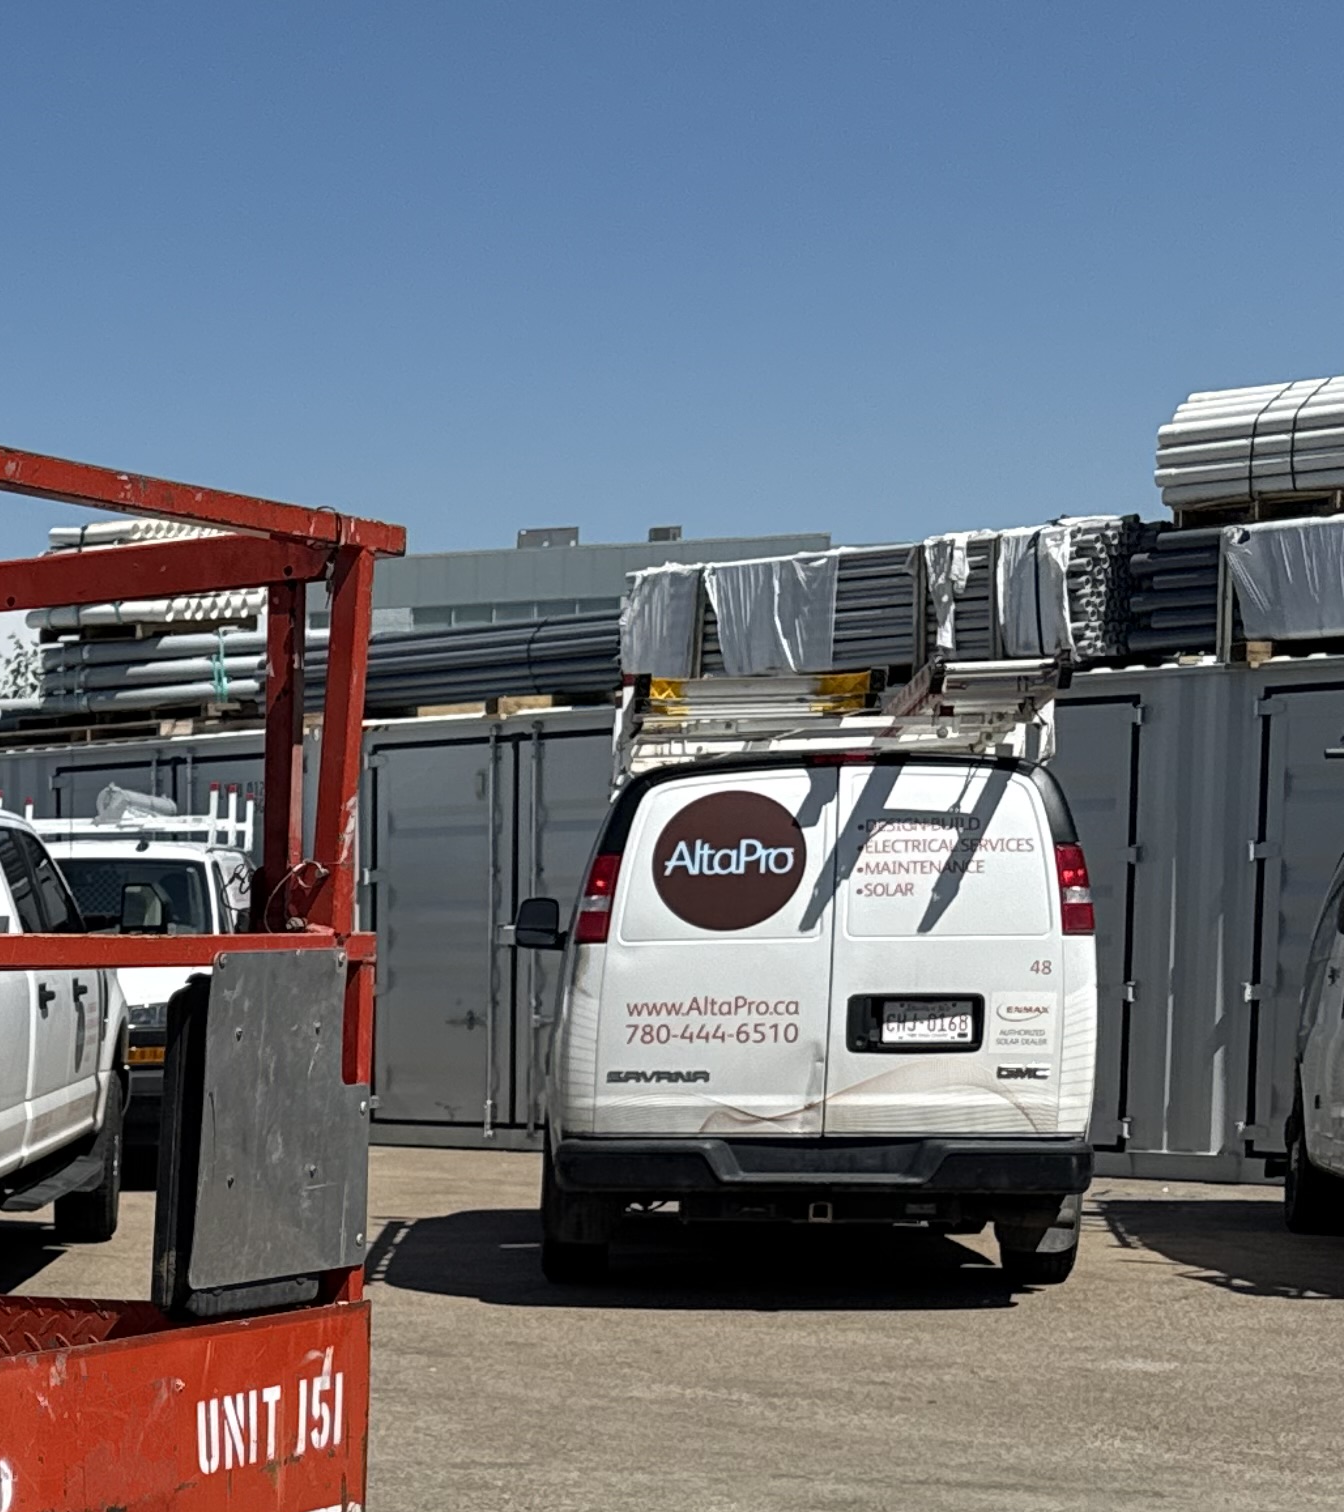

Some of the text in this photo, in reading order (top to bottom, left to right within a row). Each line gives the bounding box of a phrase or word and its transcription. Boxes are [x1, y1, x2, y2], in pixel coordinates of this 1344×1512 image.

[865, 816, 981, 833] DESIGN-BUILD
[866, 838, 1035, 854] ELECTRICAL SERVICES
[663, 838, 795, 877] AltaPro
[864, 859, 985, 875] MAINTENANCE
[863, 882, 915, 898] SOLAR
[1029, 959, 1053, 975] 48
[625, 995, 800, 1017] www.AltaPro.ca
[625, 1022, 800, 1045] 780-444-6510
[606, 1070, 711, 1084] SAVANA
[996, 1063, 1052, 1080] GMC
[196, 1371, 344, 1475] UNIT 151
